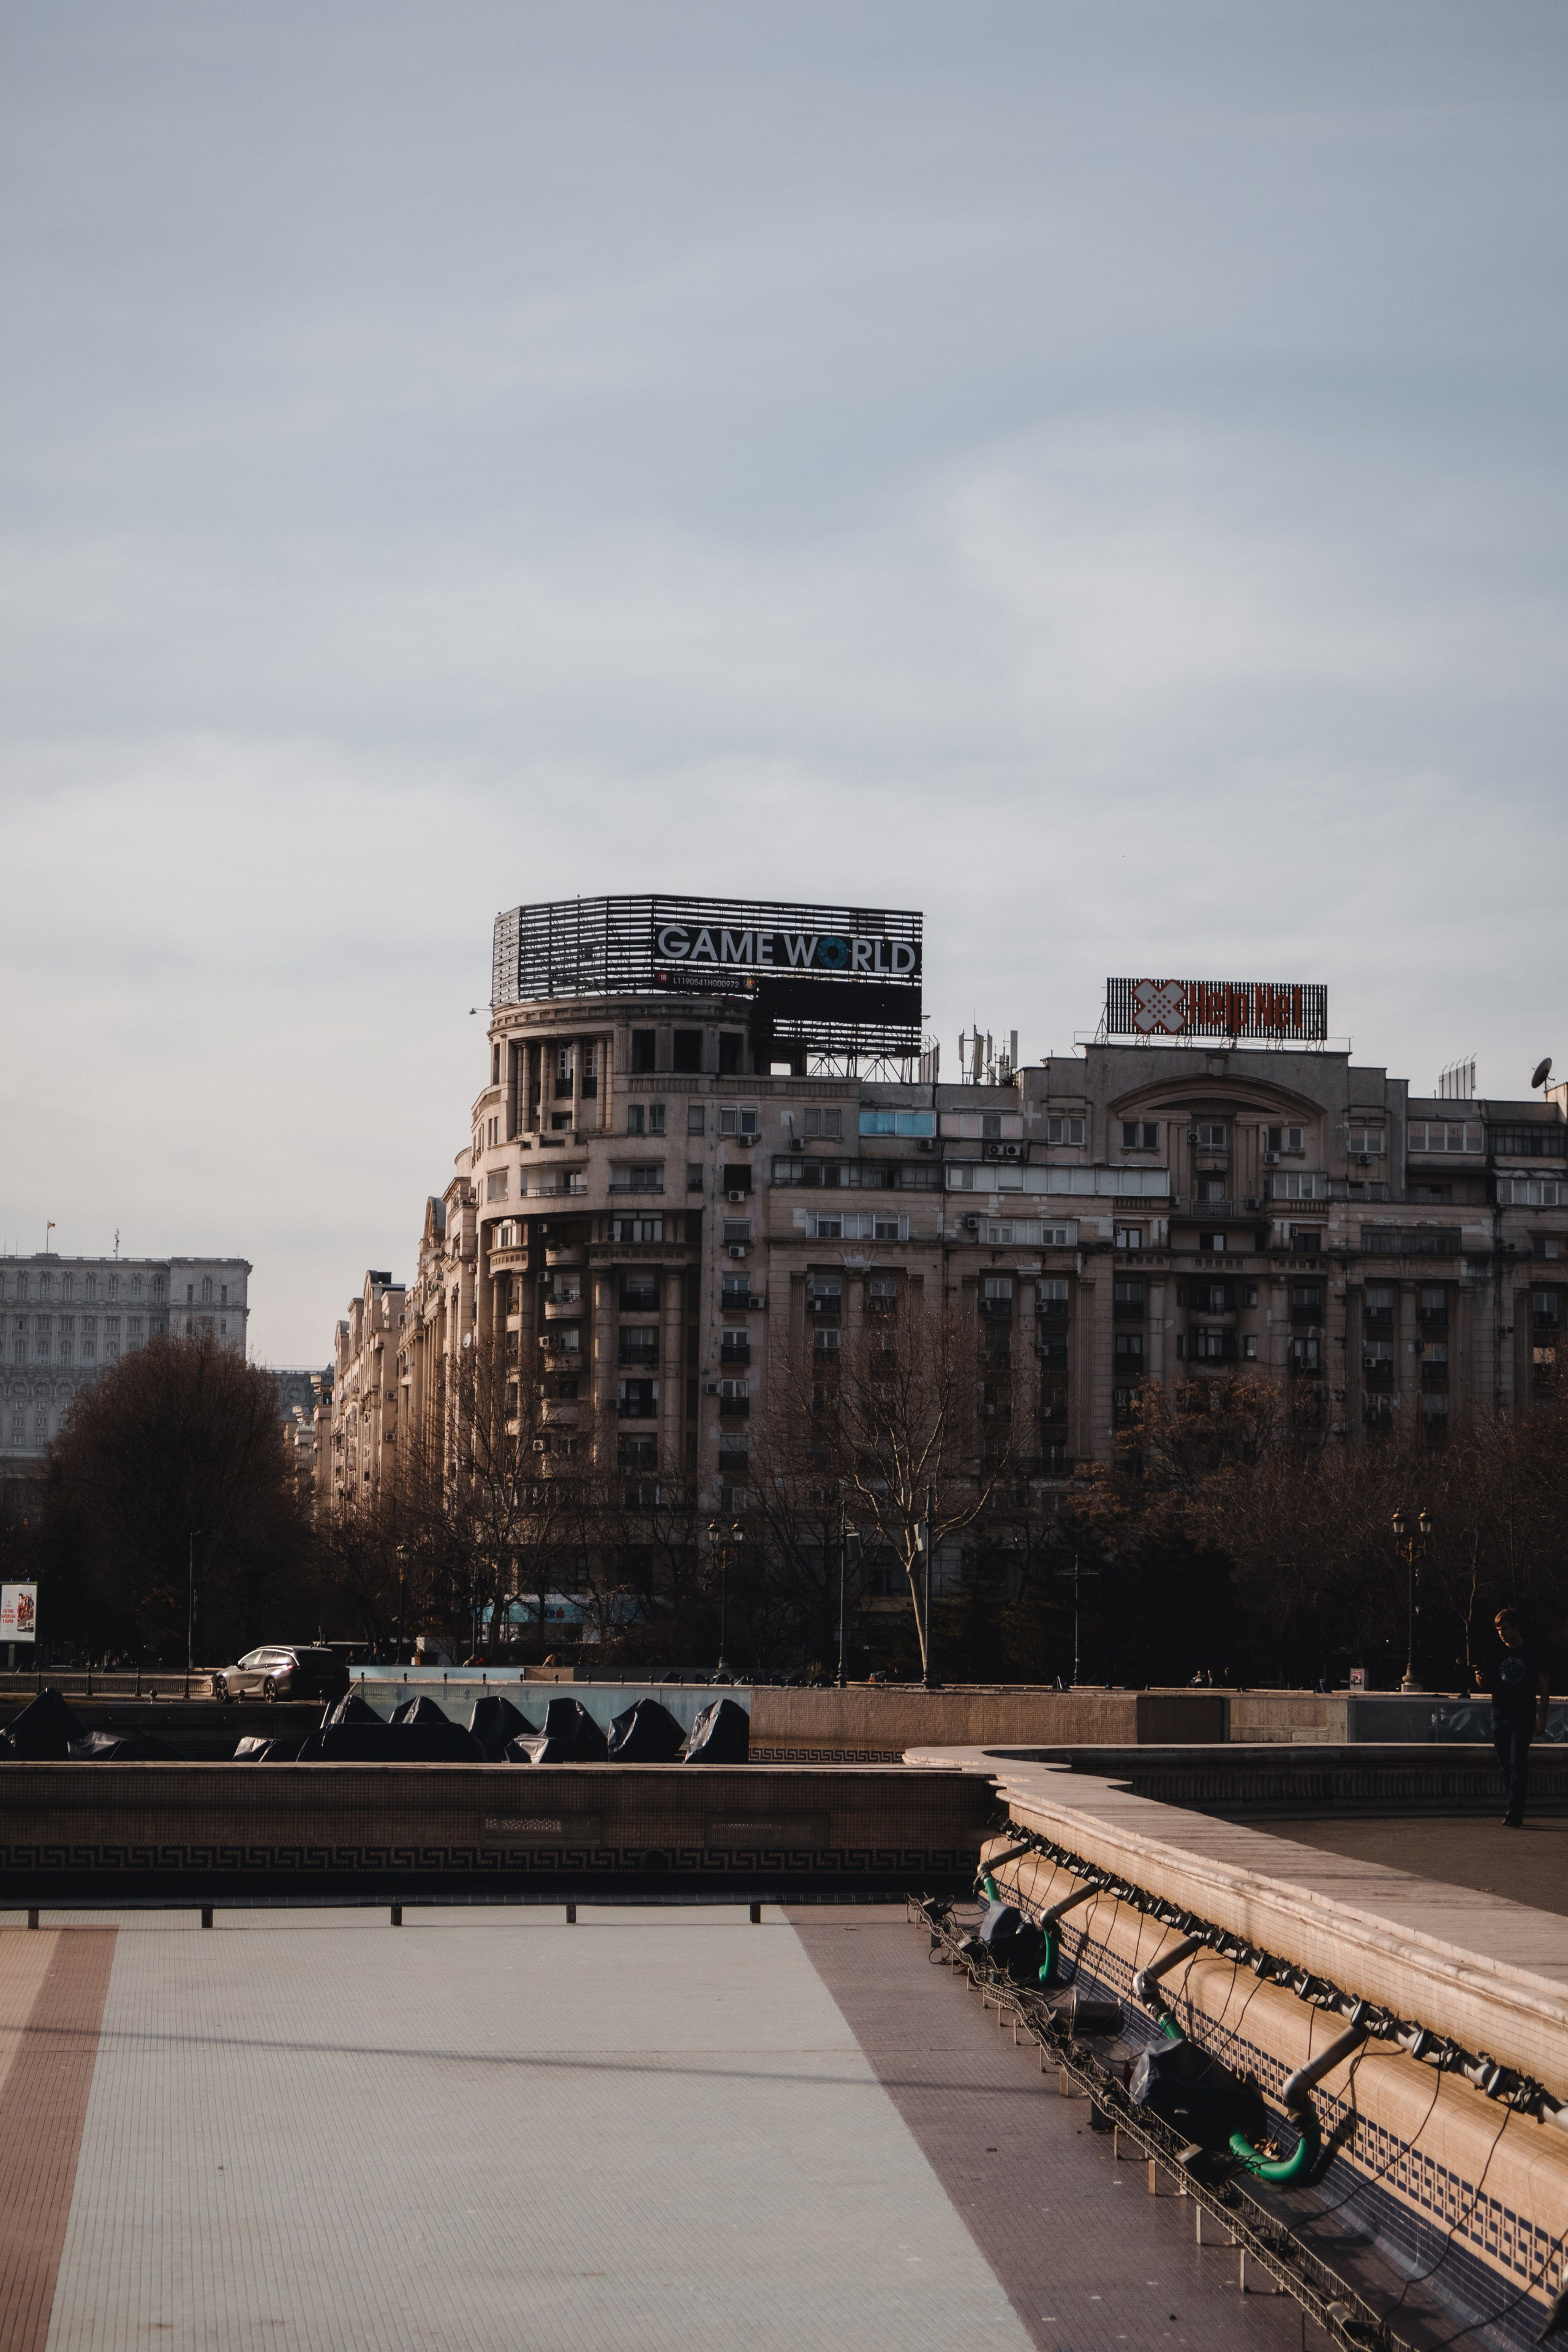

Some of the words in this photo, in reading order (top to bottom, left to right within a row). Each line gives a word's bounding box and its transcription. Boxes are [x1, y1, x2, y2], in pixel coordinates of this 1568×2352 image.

[658, 925, 773, 965] GAME
[783, 935, 916, 973] WORLD
[1189, 984, 1248, 1033] Help
[1255, 986, 1303, 1028] Net
